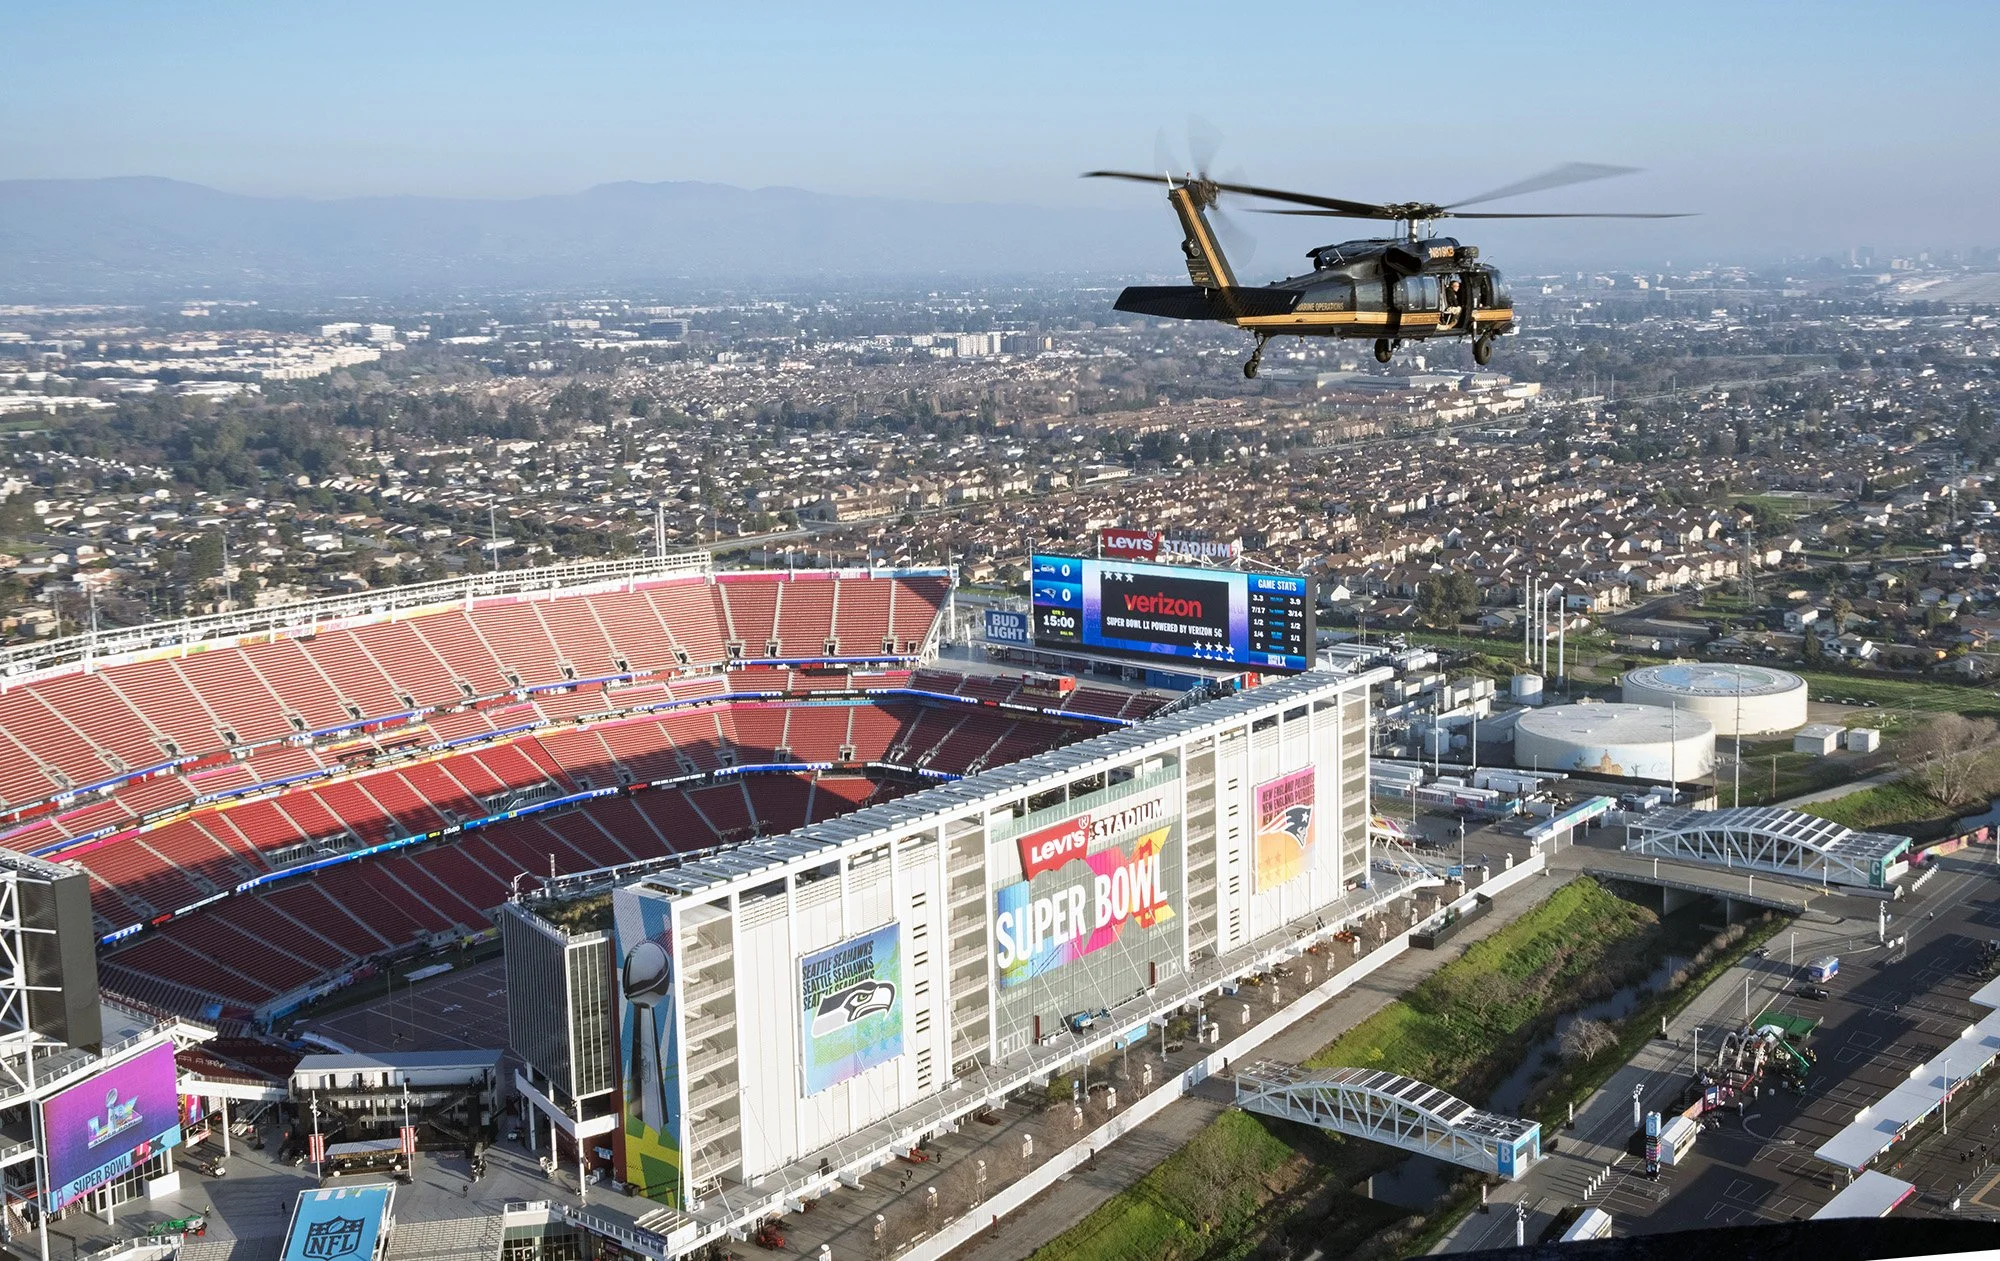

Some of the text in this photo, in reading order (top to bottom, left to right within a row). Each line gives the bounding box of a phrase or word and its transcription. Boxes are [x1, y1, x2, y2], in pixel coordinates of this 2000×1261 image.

[1315, 302, 1344, 310] OPERATIONS
[1163, 540, 1231, 558] STADIUM
[1062, 564, 1070, 576] 0
[1062, 588, 1071, 601] 0
[1258, 579, 1296, 592] GAME STATS
[1124, 592, 1202, 618] verizon
[992, 614, 1019, 627] BUD
[1043, 614, 1074, 628] 15:00
[1106, 616, 1222, 637] SUPER BOWL LX POWERED BY VERIZON 5G
[988, 625, 1024, 640] LIGHT
[1262, 772, 1314, 802] NEW ENGLAND PATRIOTS
[1262, 801, 1273, 814] NEW
[1274, 792, 1294, 810] ENGLAND
[1295, 784, 1314, 801] PATRIOTS
[1095, 799, 1164, 837] STADIUM
[1872, 862, 1880, 876] C
[996, 852, 1168, 969] SUPER BOWL
[802, 940, 874, 980] SEATTLE SEAHAWKS
[803, 956, 874, 996] SEATTLE SEAHAWKS
[1649, 1121, 1655, 1133] B
[1502, 1144, 1510, 1163] B
[73, 1135, 166, 1196] SUPER BOWL LX
[308, 1234, 354, 1256] NFL
